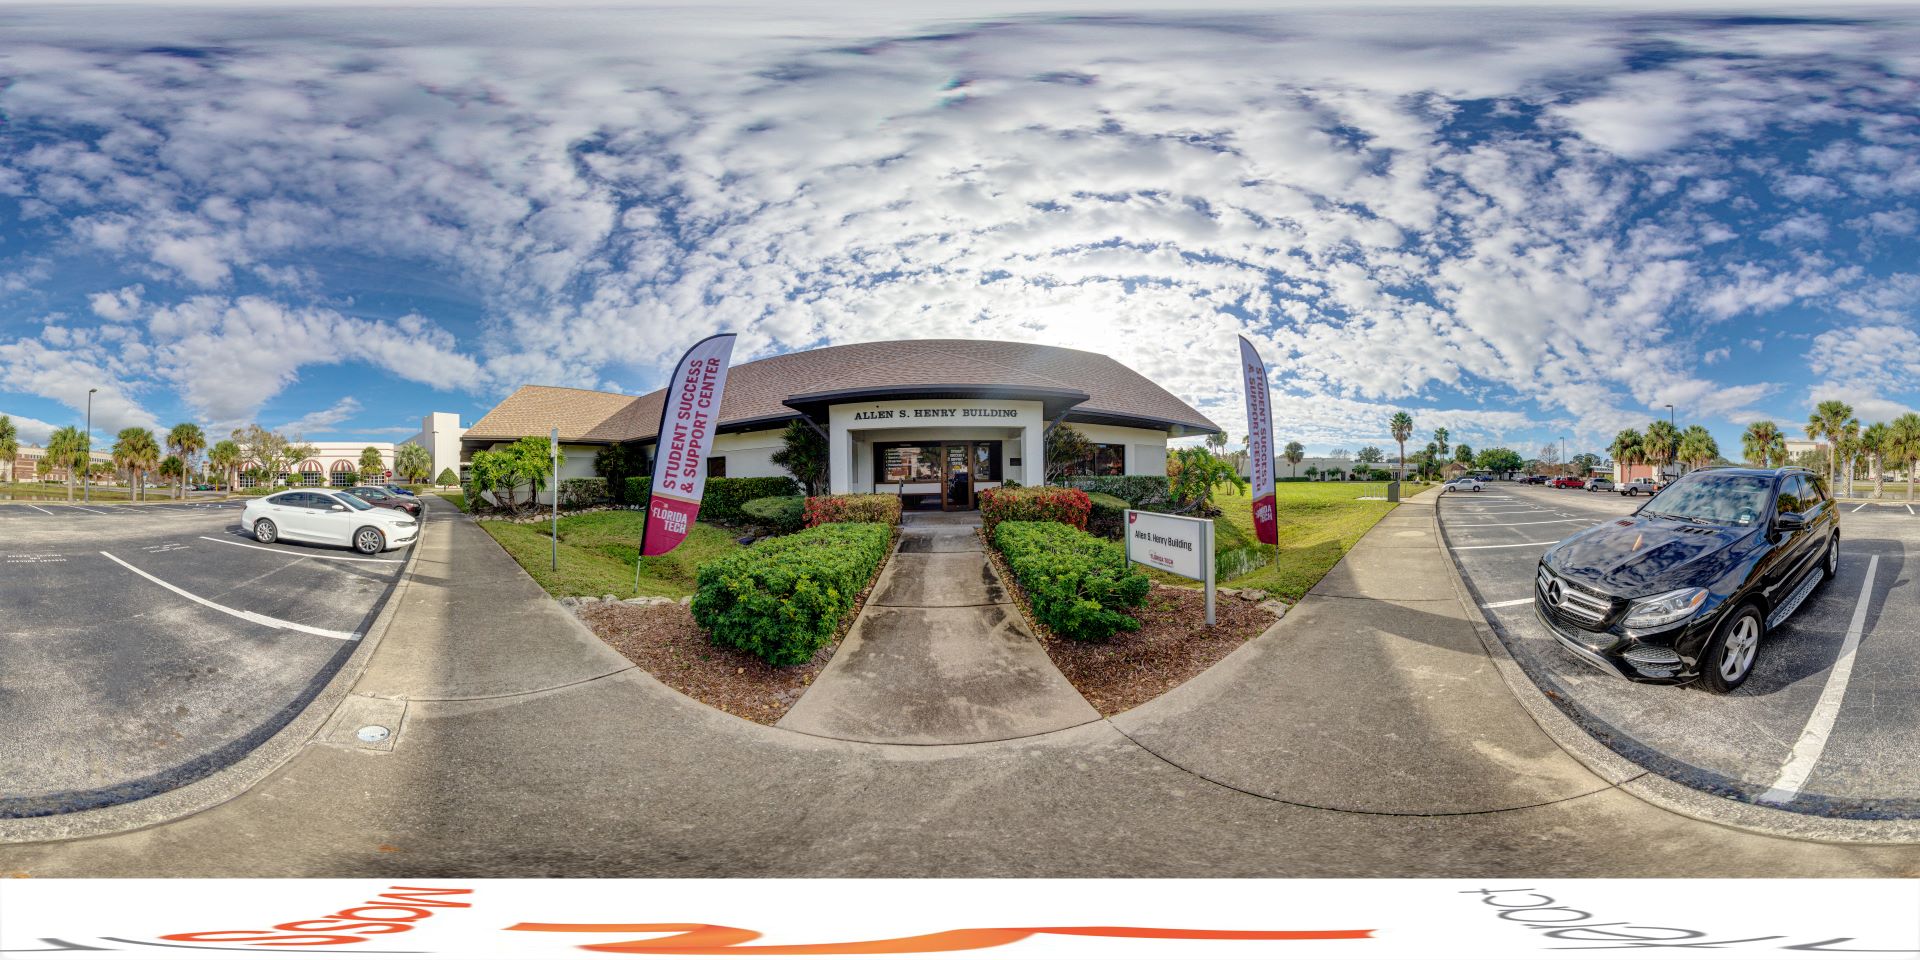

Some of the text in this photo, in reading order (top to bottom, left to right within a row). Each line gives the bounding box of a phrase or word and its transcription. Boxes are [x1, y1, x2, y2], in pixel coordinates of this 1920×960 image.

[663, 359, 703, 490] STUDENT SUCCESS
[680, 357, 720, 494] & SUPPORT CENTER
[854, 408, 1018, 421] ALLEN S. HENRY BUILDING
[1248, 376, 1260, 437] SUPPORT
[1255, 367, 1268, 487] STUDENT SUCCESS
[653, 507, 687, 523] FLORIDA
[664, 519, 686, 534] TECH
[1135, 530, 1147, 540] Allen
[1153, 534, 1168, 546] Henry
[1168, 537, 1192, 552] Building
